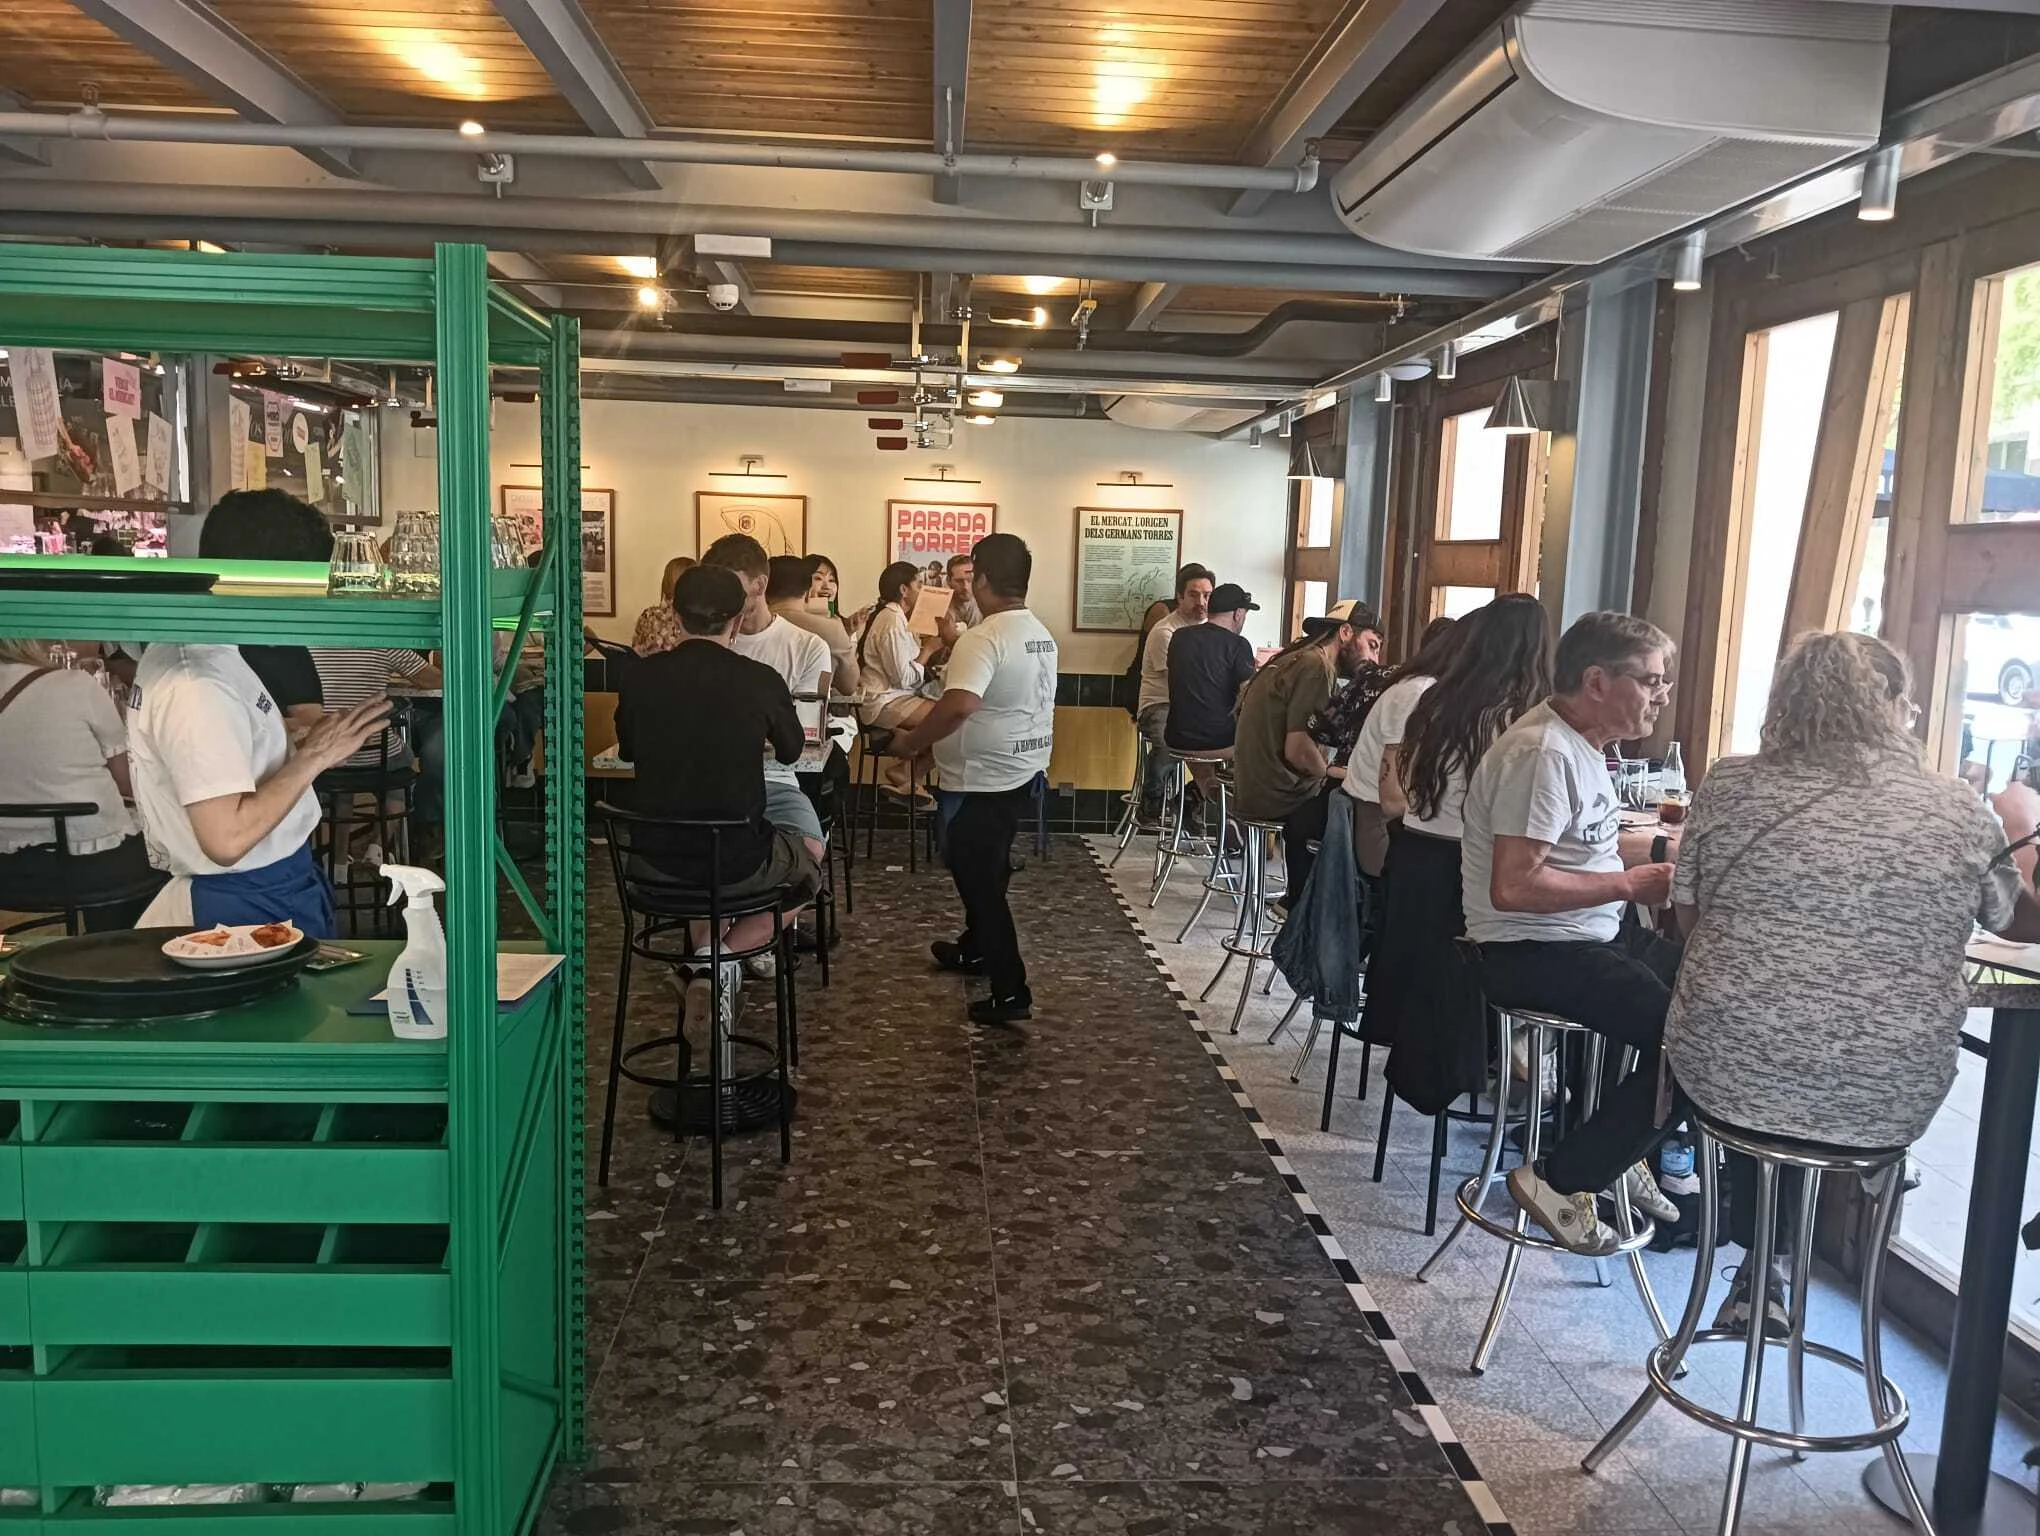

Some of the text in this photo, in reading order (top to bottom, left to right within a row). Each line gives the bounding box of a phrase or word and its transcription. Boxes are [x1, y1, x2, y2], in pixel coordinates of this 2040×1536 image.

[897, 509, 986, 532] PARADA
[1090, 515, 1100, 526] EL
[1135, 517, 1169, 528] L'ORIGEN
[1084, 527, 1174, 541] DELS GERMANS TORRES
